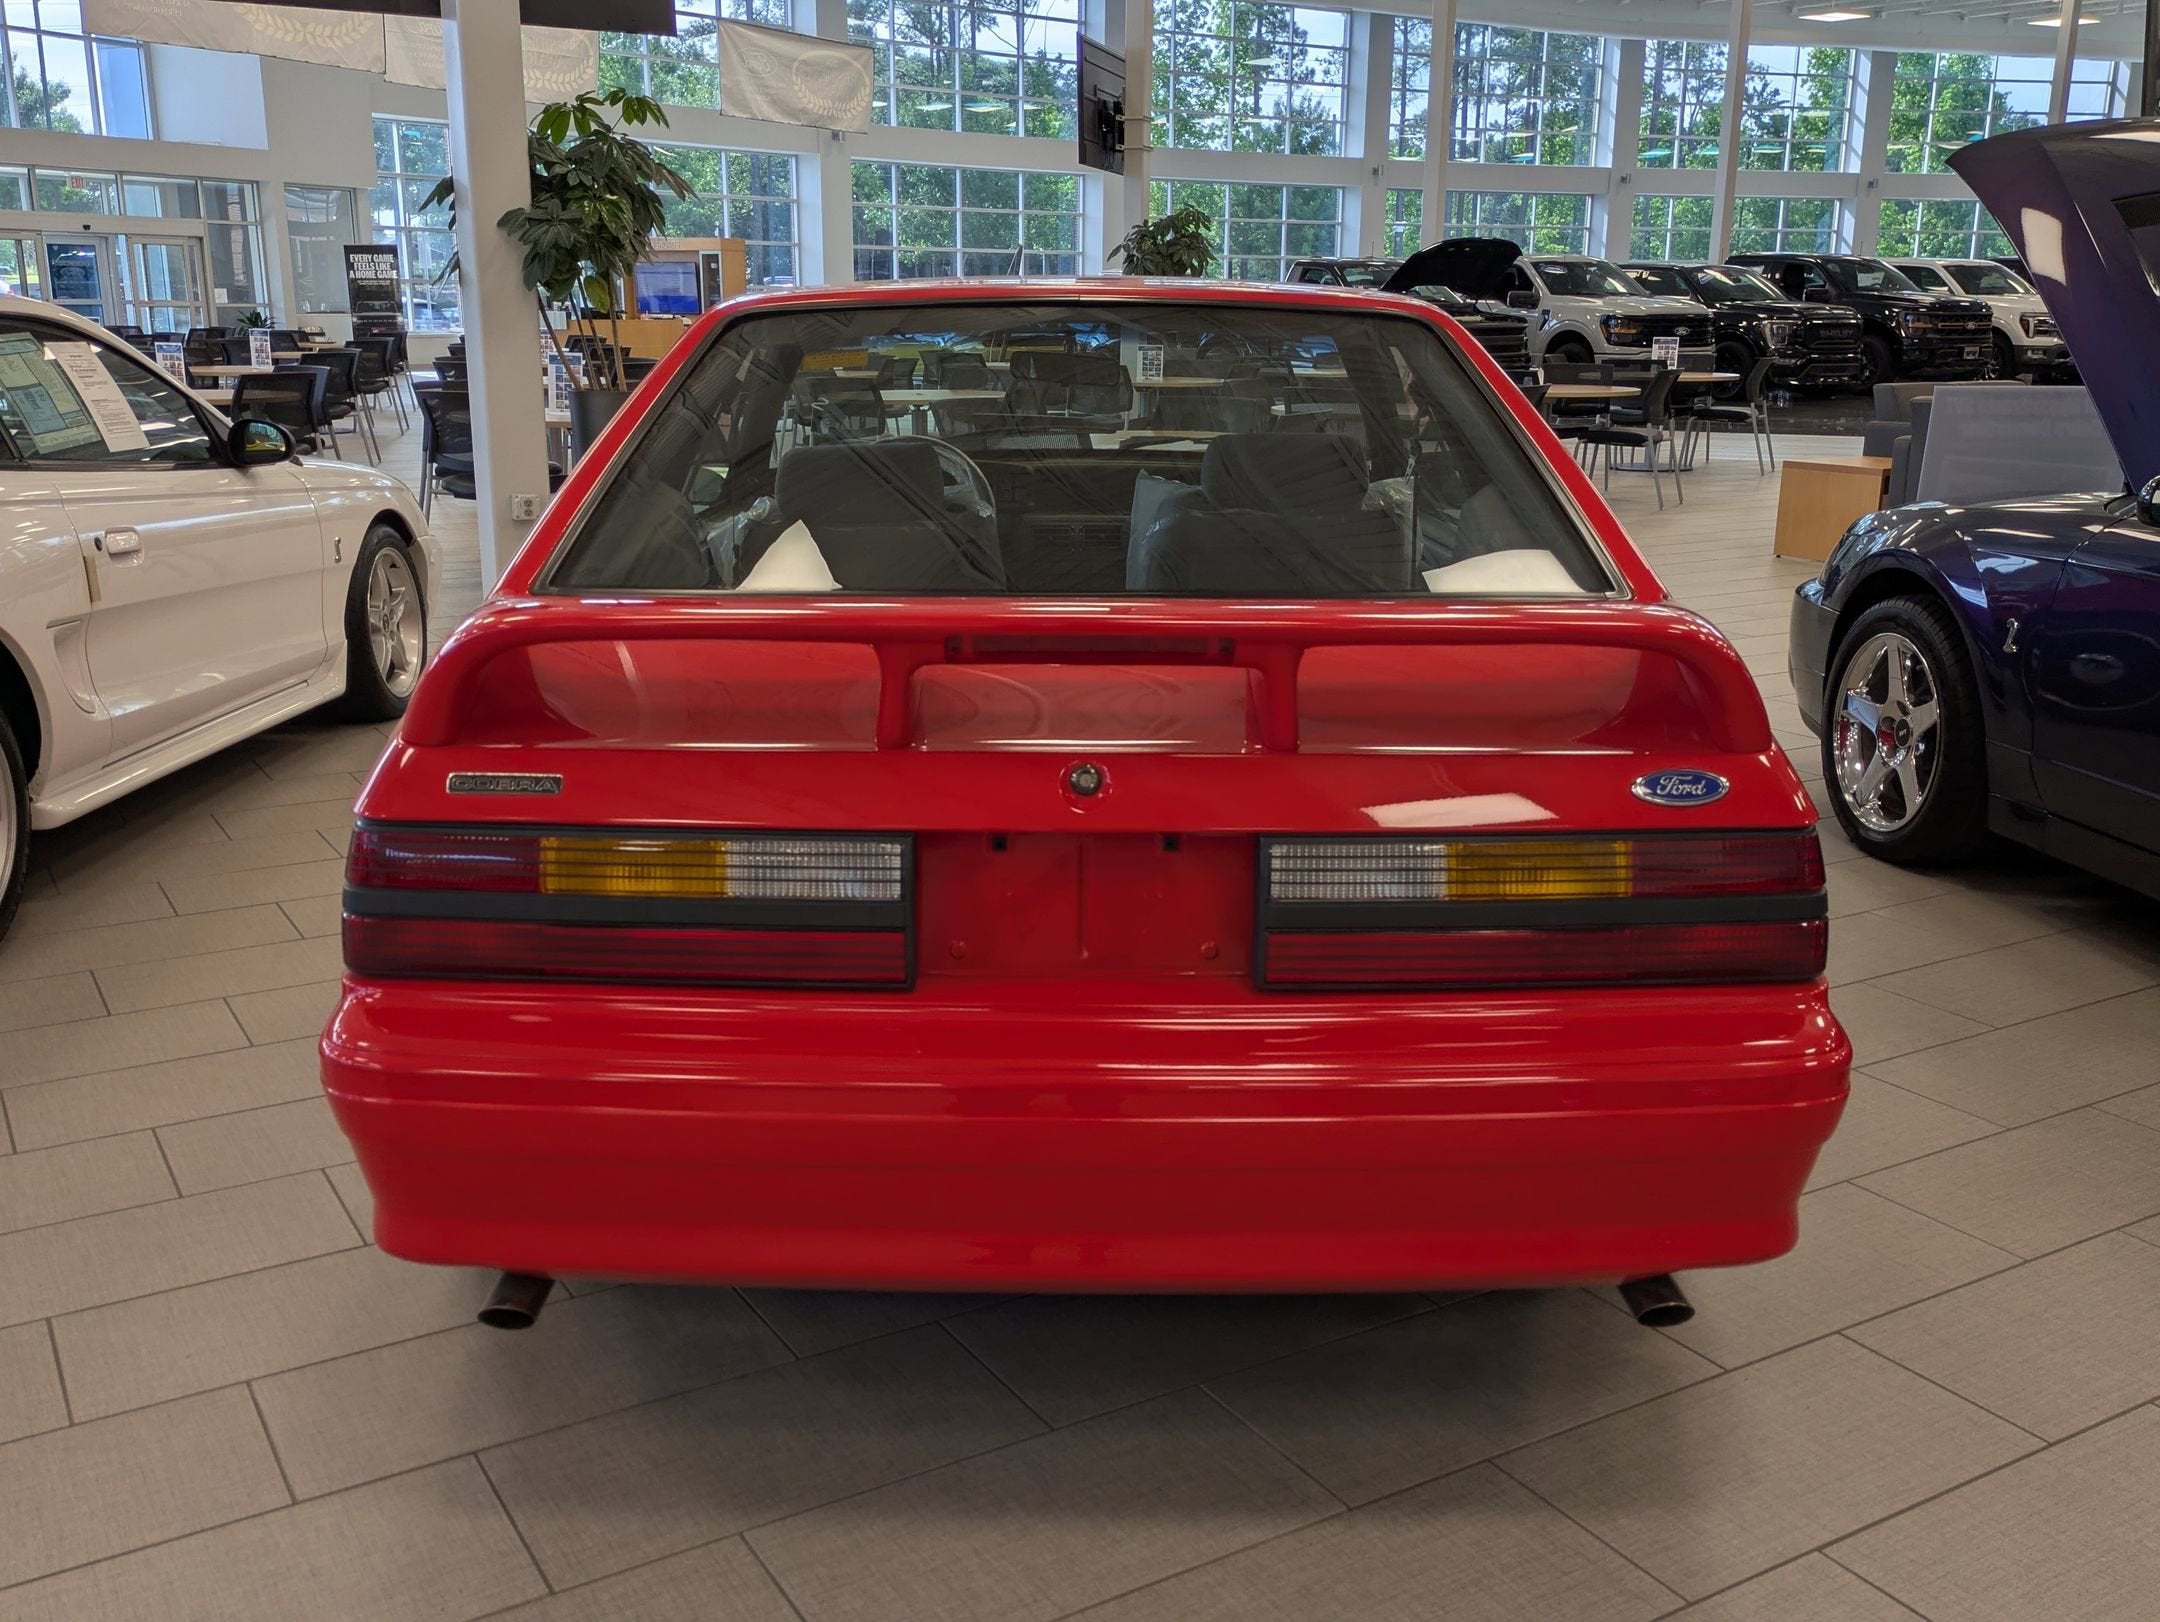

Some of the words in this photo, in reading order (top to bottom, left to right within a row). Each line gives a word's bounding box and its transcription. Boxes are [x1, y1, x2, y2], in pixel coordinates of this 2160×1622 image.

[349, 254, 372, 262] EVERY
[373, 254, 394, 262] GAME
[354, 262, 375, 270] FEELS
[376, 262, 391, 270] LIKE
[349, 270, 355, 278] A
[356, 270, 376, 278] HOME
[377, 270, 398, 278] GAME
[451, 777, 559, 794] COBRA
[1656, 775, 1707, 796] Ford
